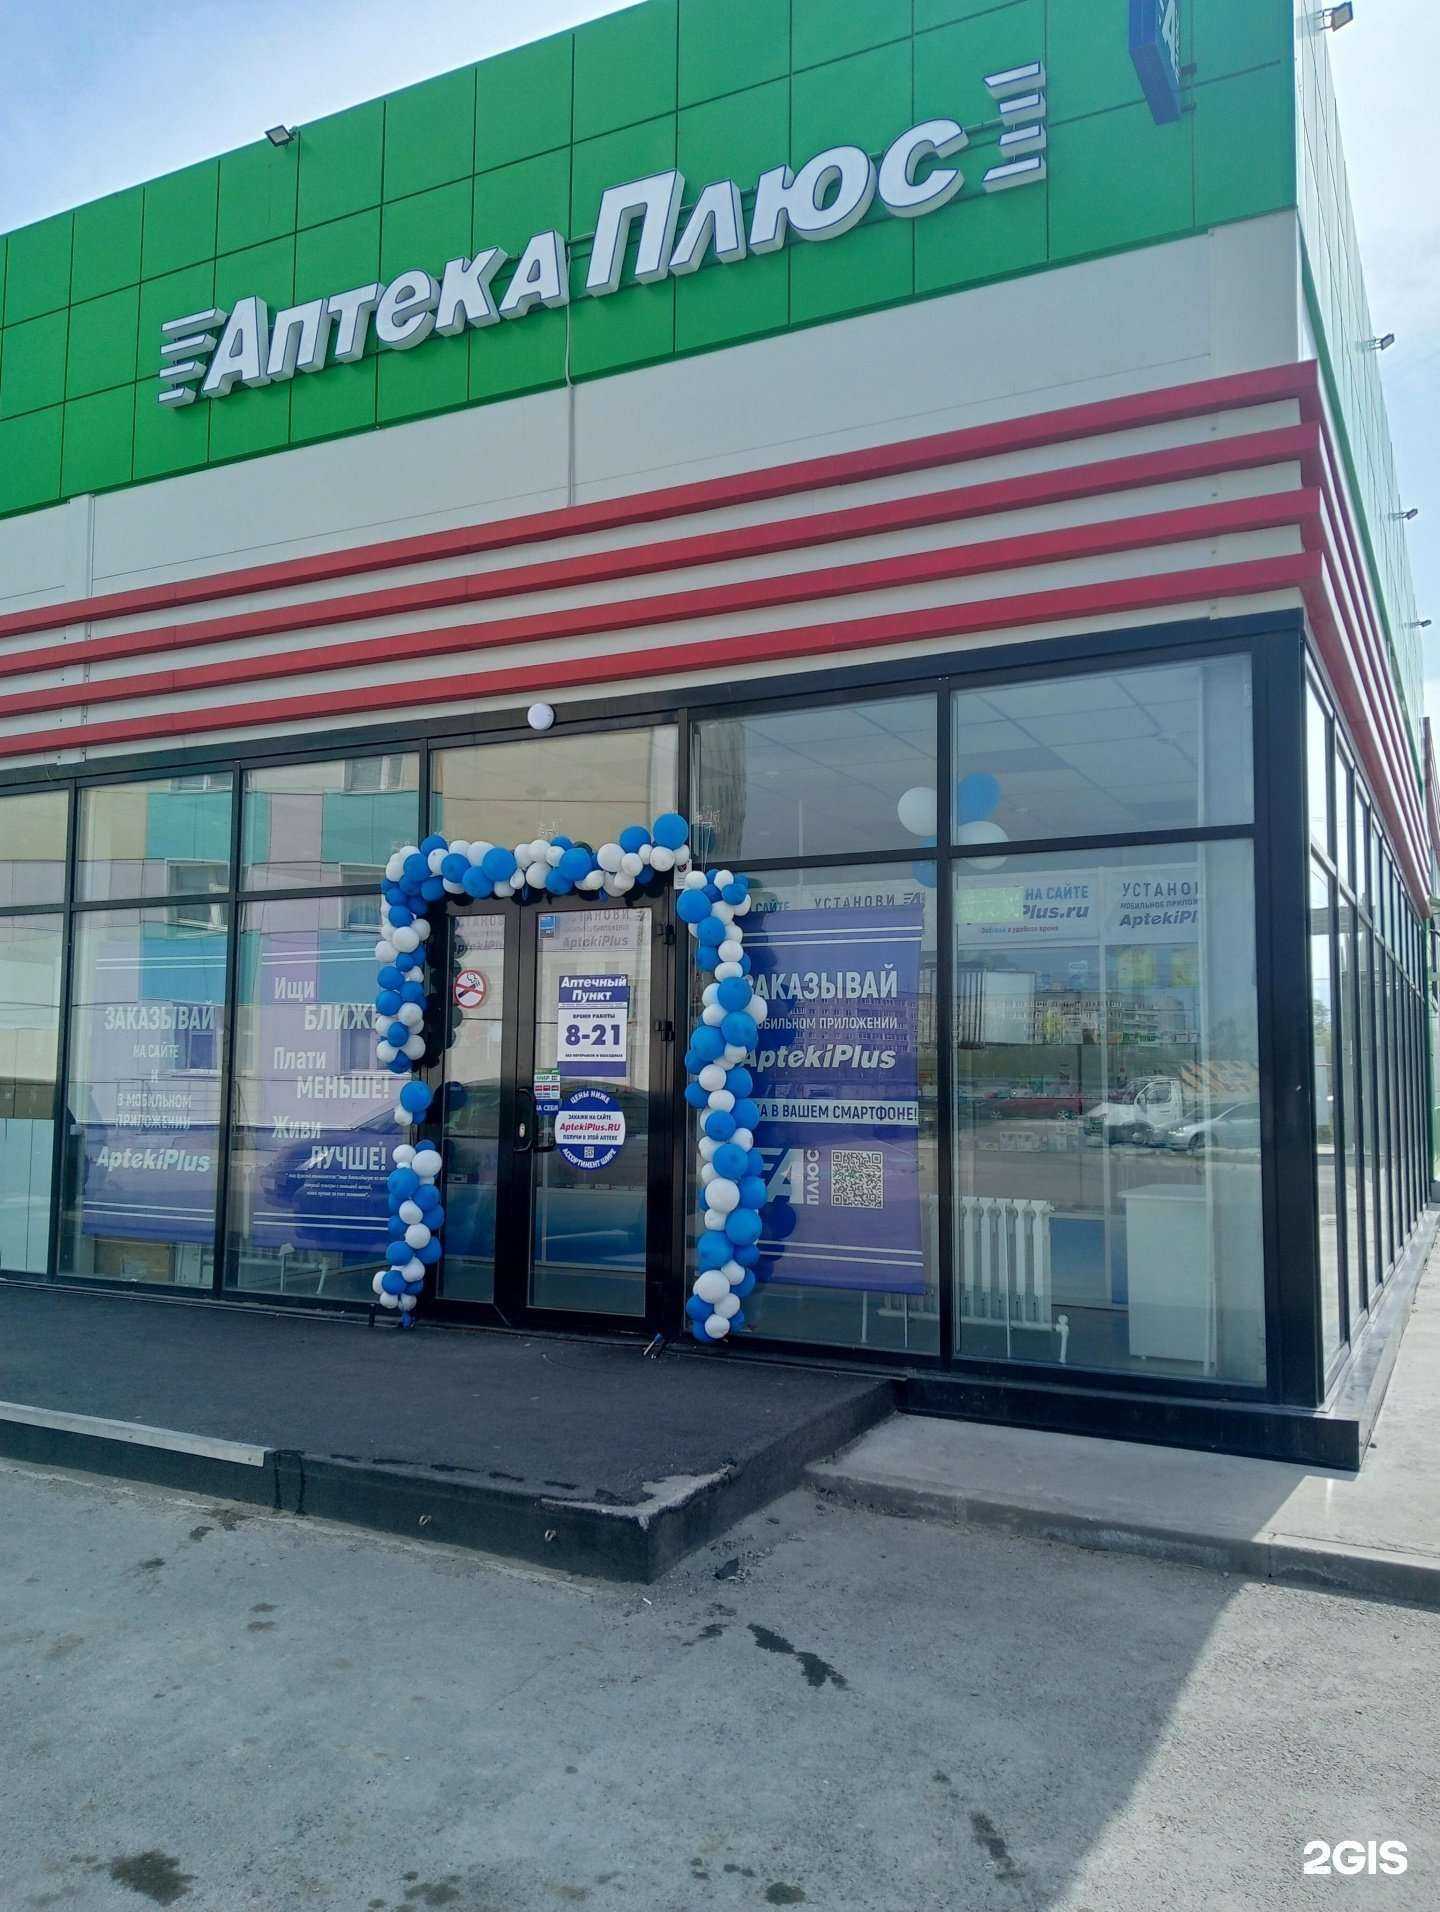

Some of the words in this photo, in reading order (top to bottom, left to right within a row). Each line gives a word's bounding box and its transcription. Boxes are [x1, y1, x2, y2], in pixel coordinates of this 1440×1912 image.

[815, 894, 896, 909] УСТАНОВИ
[1025, 888, 1043, 901] НА
[1046, 881, 1089, 899] САЙТЕ
[274, 977, 315, 1001] Ищи
[561, 976, 627, 988] Аптечный
[572, 989, 612, 1003] Пункт
[104, 999, 217, 1031] ЗАКАЗЫВАЙ
[757, 1017, 816, 1030] ОБИЛЬНОМ
[819, 1017, 897, 1030] ПРИЛОЖЕНИИ
[565, 1024, 620, 1046] 8-21
[133, 1044, 148, 1058] НА
[149, 1041, 180, 1058] САЙТЕ
[273, 1046, 327, 1070] Плати
[741, 1044, 897, 1073] AptekiPlus
[297, 1076, 390, 1099] МЕНЬШЕ!
[127, 1093, 193, 1109] МОБИЛЬНОМ
[771, 1105, 779, 1116] В
[783, 1105, 829, 1118] ВАШЕМ
[832, 1105, 917, 1121] СМАРТФОНЕ!
[272, 1115, 321, 1139] Живи
[560, 1122, 621, 1133] AptekiPlus.RU
[97, 1146, 211, 1172] AptekiPlus
[308, 1144, 387, 1171] ЛУЧШЕ!
